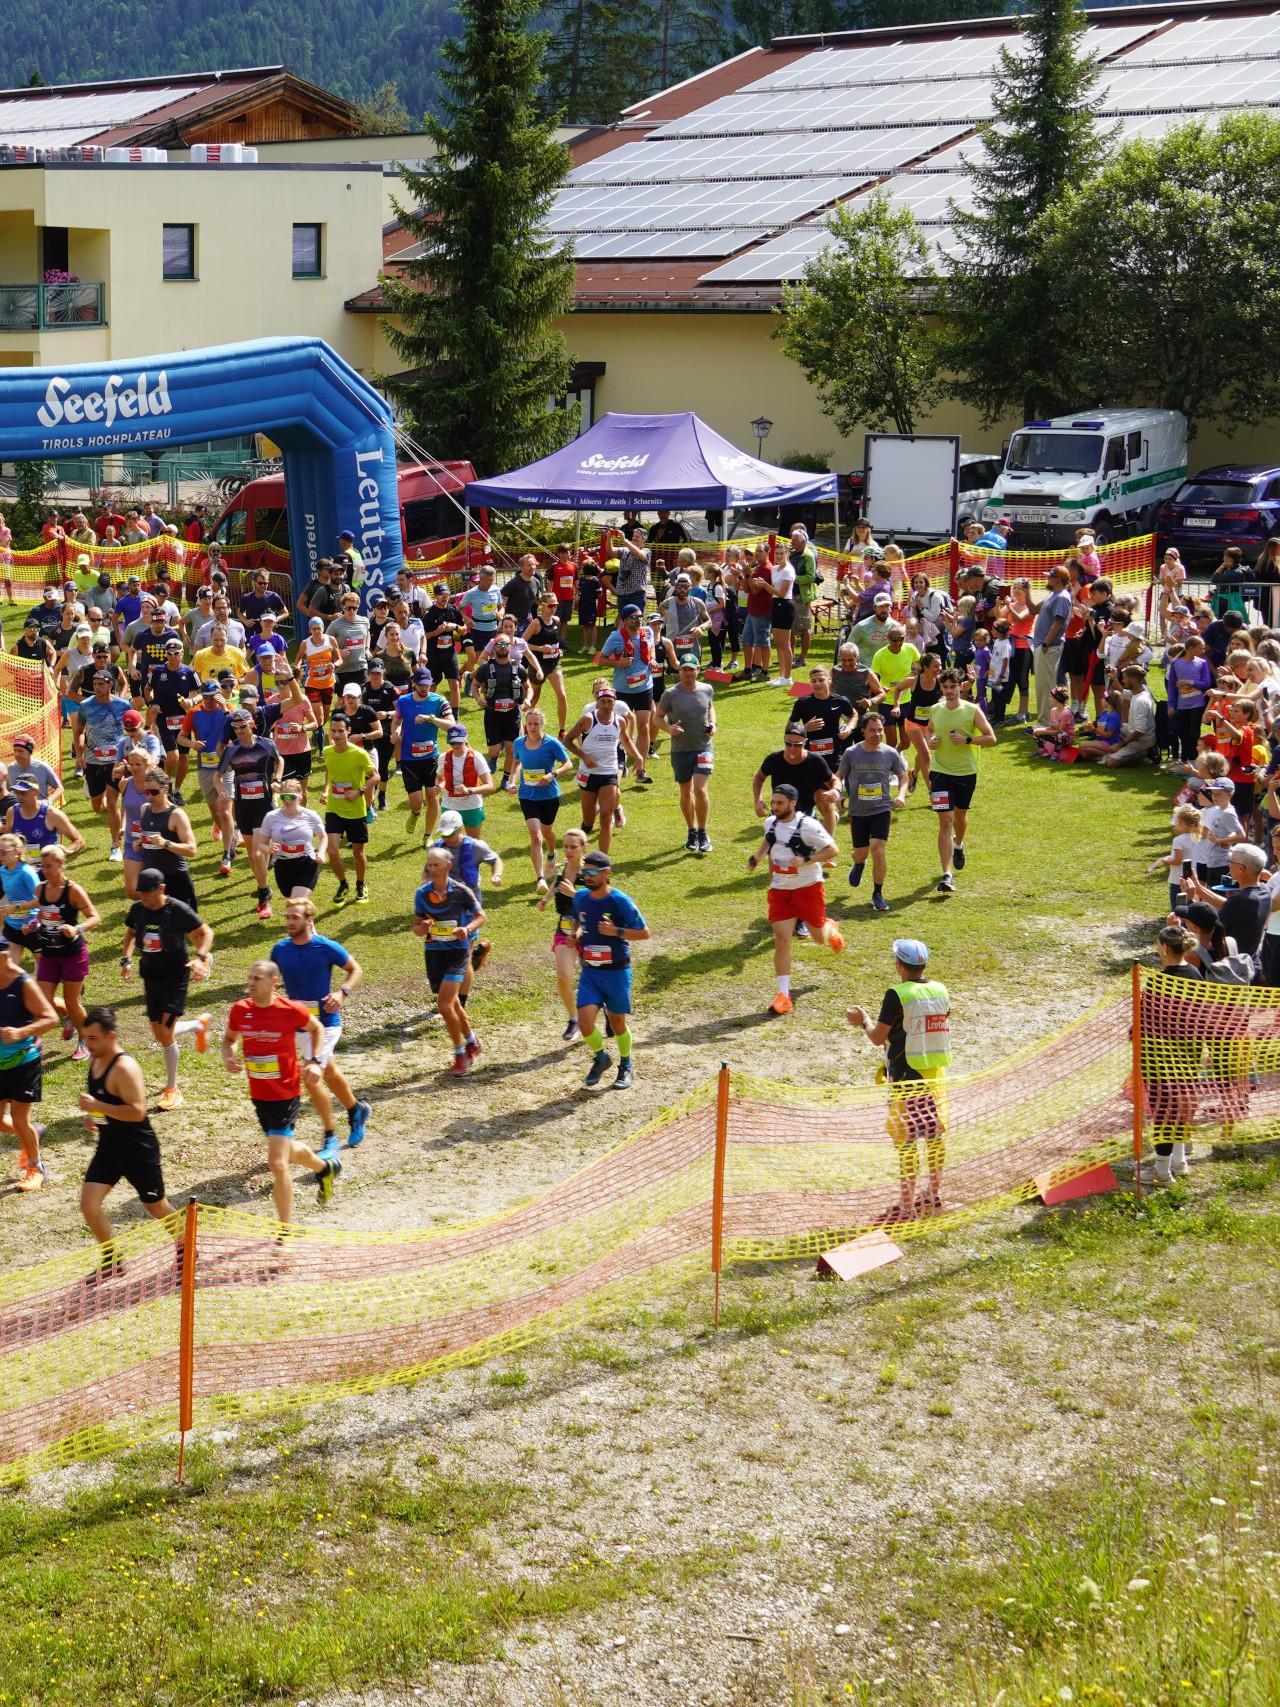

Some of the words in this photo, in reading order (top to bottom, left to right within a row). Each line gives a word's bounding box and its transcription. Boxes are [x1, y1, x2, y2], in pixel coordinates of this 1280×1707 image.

[37, 370, 172, 428] Seefeld
[42, 437, 84, 450] TIROLS
[88, 428, 171, 447] HOCHPLATEAU
[580, 453, 650, 471] Seefeld
[545, 497, 571, 505] Leutasch
[355, 447, 386, 617] Leutasc
